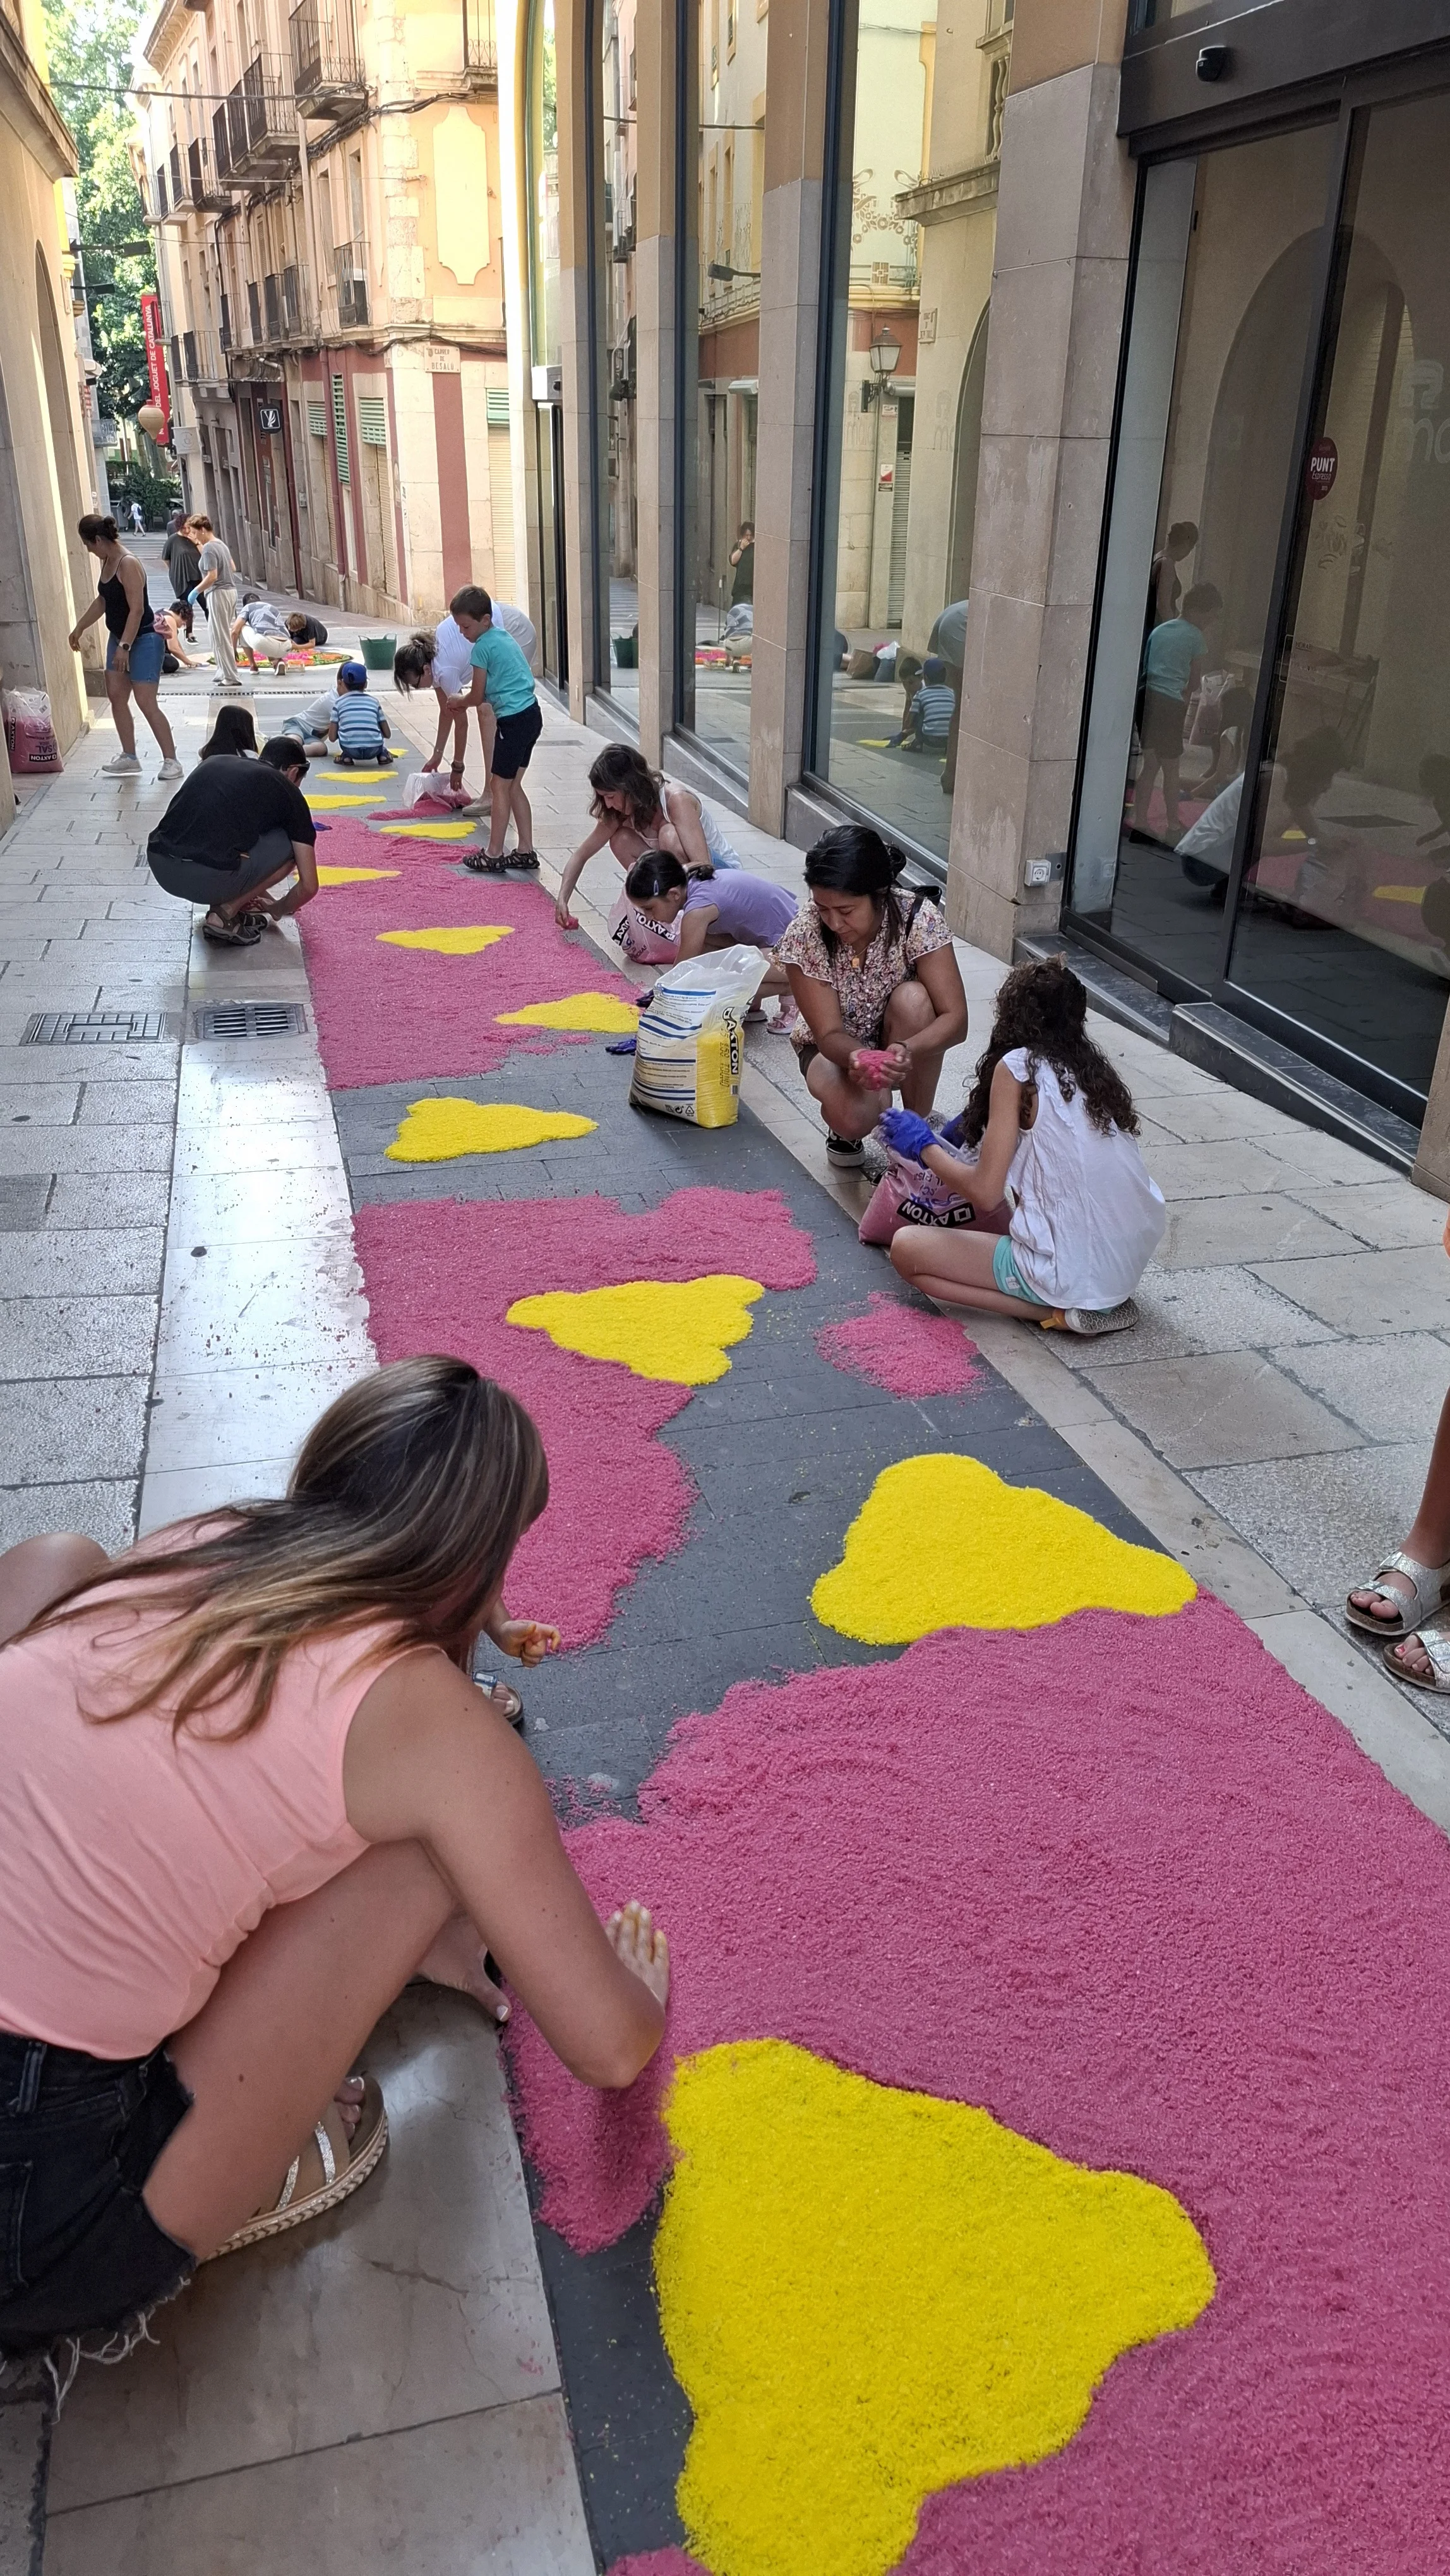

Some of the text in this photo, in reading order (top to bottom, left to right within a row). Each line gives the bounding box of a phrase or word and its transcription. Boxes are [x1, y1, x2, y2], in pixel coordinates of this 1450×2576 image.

[145, 304, 155, 347] CATALUNYA
[150, 350, 156, 361] DE
[152, 362, 160, 391] JOGUET
[1310, 457, 1335, 472] PUNT
[36, 745, 52, 754] SAL
[616, 919, 630, 939] AXTO
[728, 1020, 738, 1074] AXTON
[902, 1202, 949, 1225] AXTON
